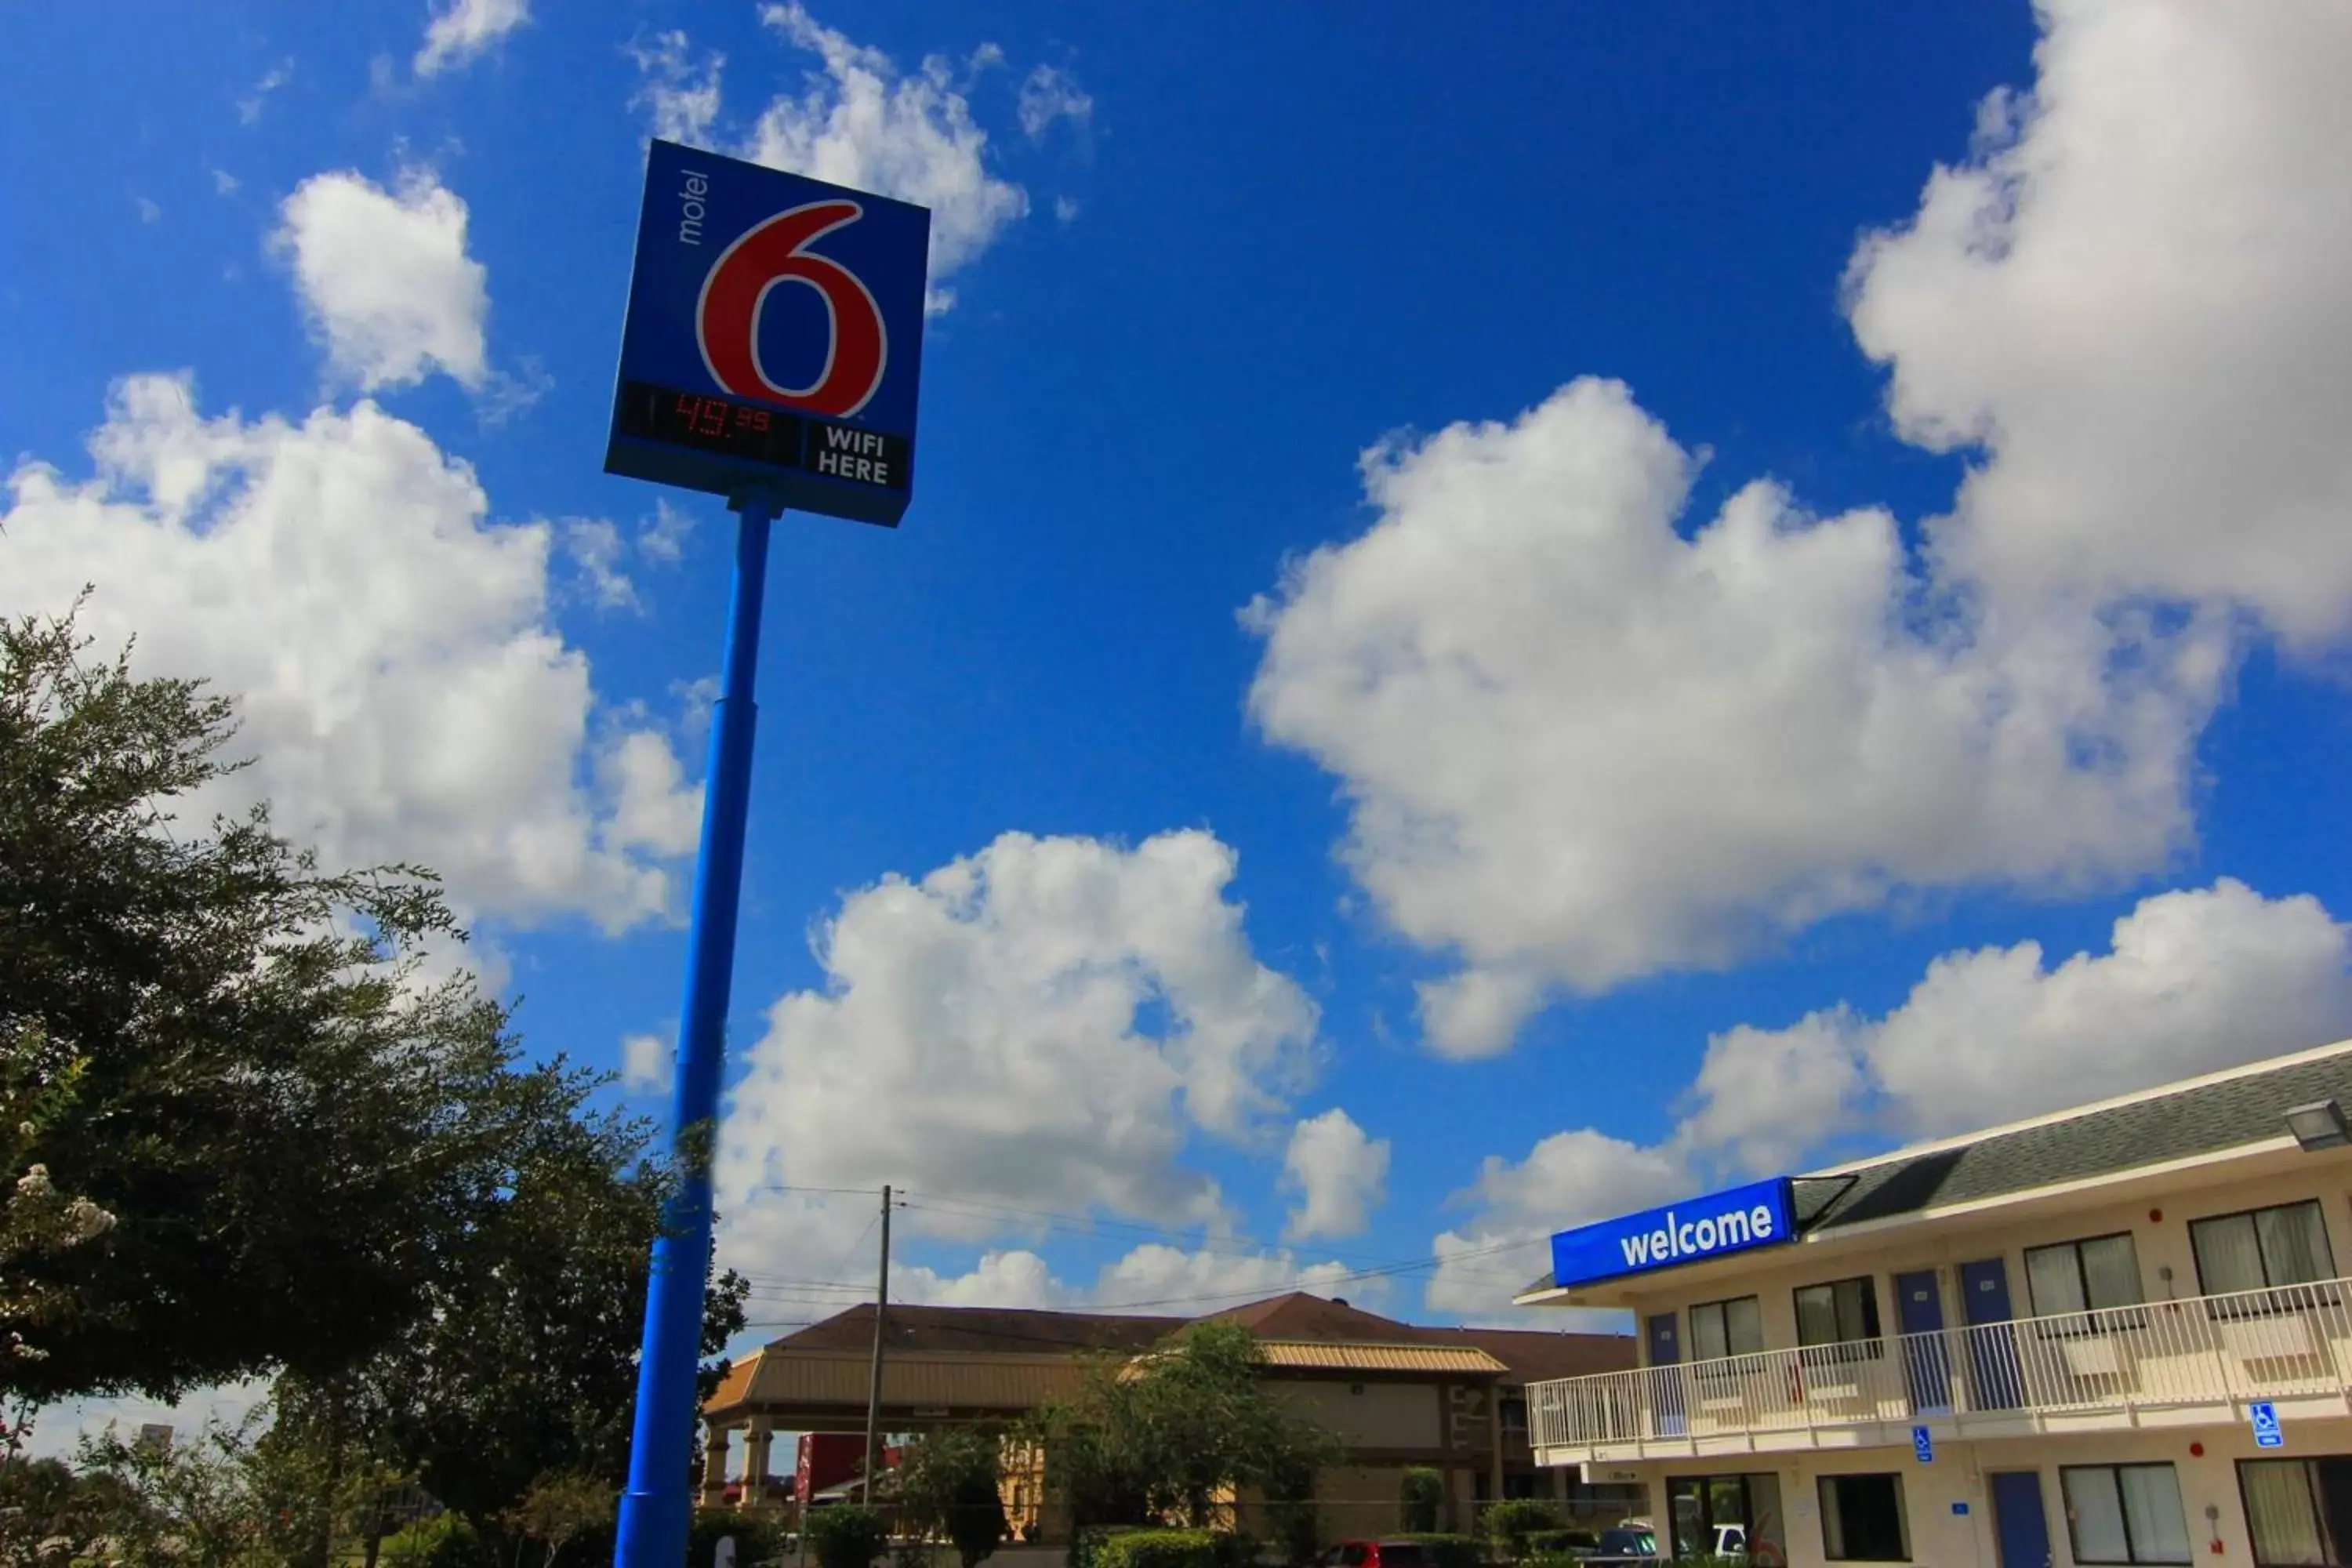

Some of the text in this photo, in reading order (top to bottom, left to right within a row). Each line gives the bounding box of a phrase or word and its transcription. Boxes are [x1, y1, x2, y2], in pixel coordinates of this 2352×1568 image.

[678, 169, 709, 245] motel
[695, 199, 887, 419] 6
[818, 451, 887, 484] HERE
[826, 426, 884, 457] WIFI
[1621, 1204, 1773, 1267] welcome
